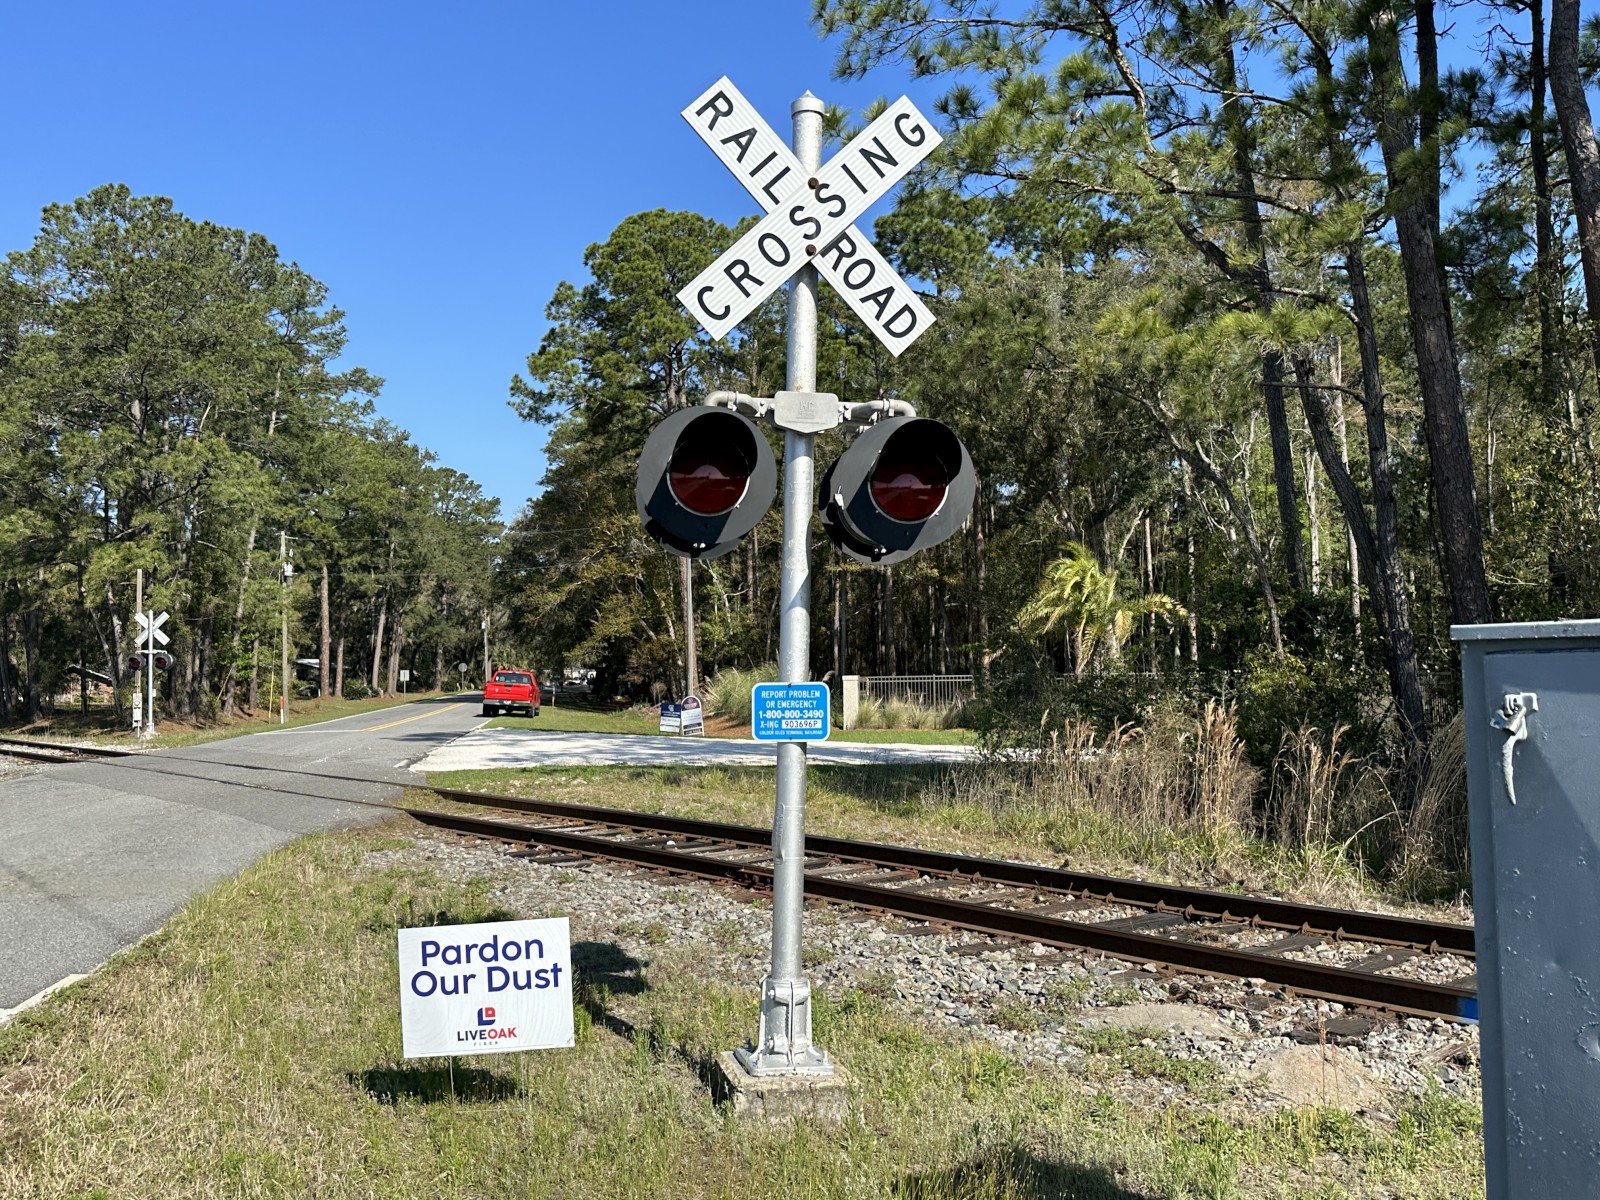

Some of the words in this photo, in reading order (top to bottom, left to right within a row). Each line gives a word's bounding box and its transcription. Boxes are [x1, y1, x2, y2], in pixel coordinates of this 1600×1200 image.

[695, 90, 791, 205] RAIL
[820, 231, 917, 338] ROAD
[697, 113, 926, 320] CROSSING
[761, 690, 787, 698] REPORT
[789, 690, 820, 698] PROBLEM
[766, 700, 775, 708] OR
[777, 700, 817, 708] EMERGENCY
[759, 709, 824, 718] 1-800-800-3490
[760, 720, 779, 728] X-ING
[784, 720, 818, 728] 903696P
[421, 935, 544, 966] Pardon
[411, 970, 477, 997] Our
[487, 963, 562, 992] Dust
[457, 1027, 517, 1041] LIVEOAK
